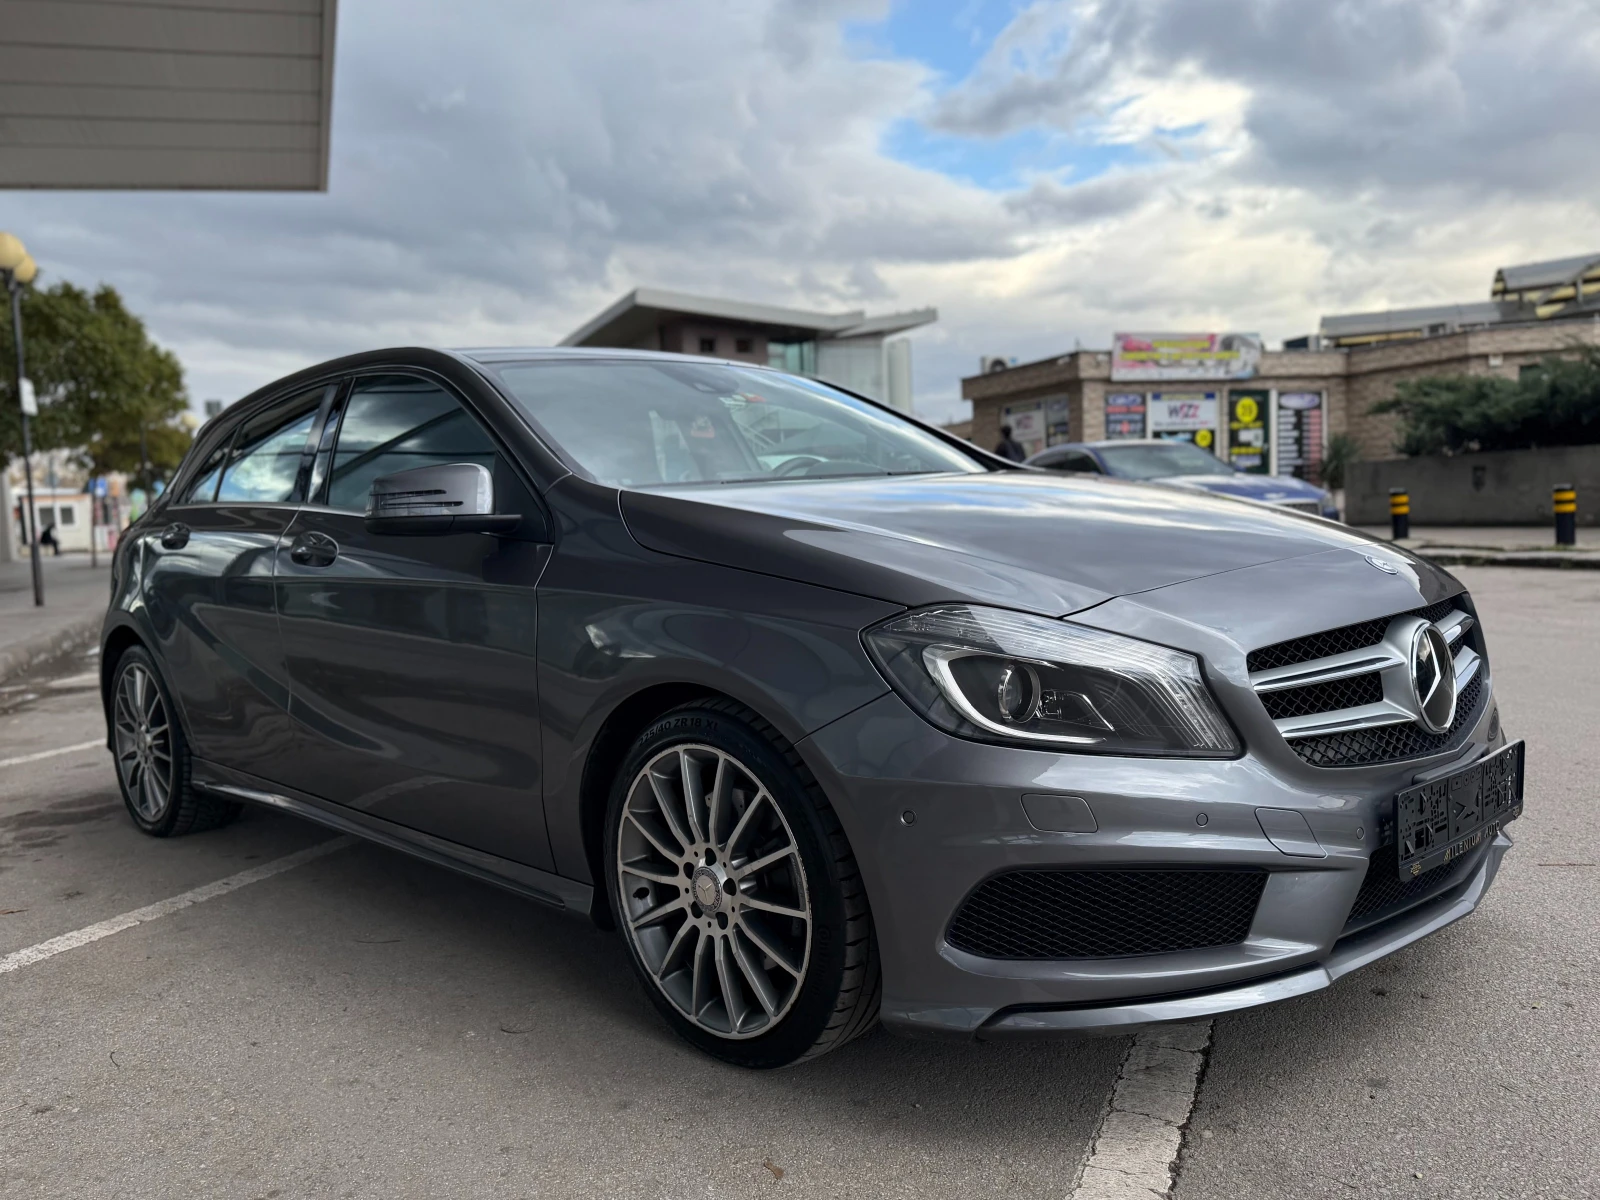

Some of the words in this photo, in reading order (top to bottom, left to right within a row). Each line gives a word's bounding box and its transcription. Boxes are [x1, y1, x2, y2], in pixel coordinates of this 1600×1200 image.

[639, 721, 671, 747] 225/40
[674, 717, 688, 728] ZR
[690, 717, 702, 727] 18
[705, 719, 718, 732] XL
[1443, 832, 1482, 862] MILENIUM
[1484, 820, 1500, 839] AUTO
